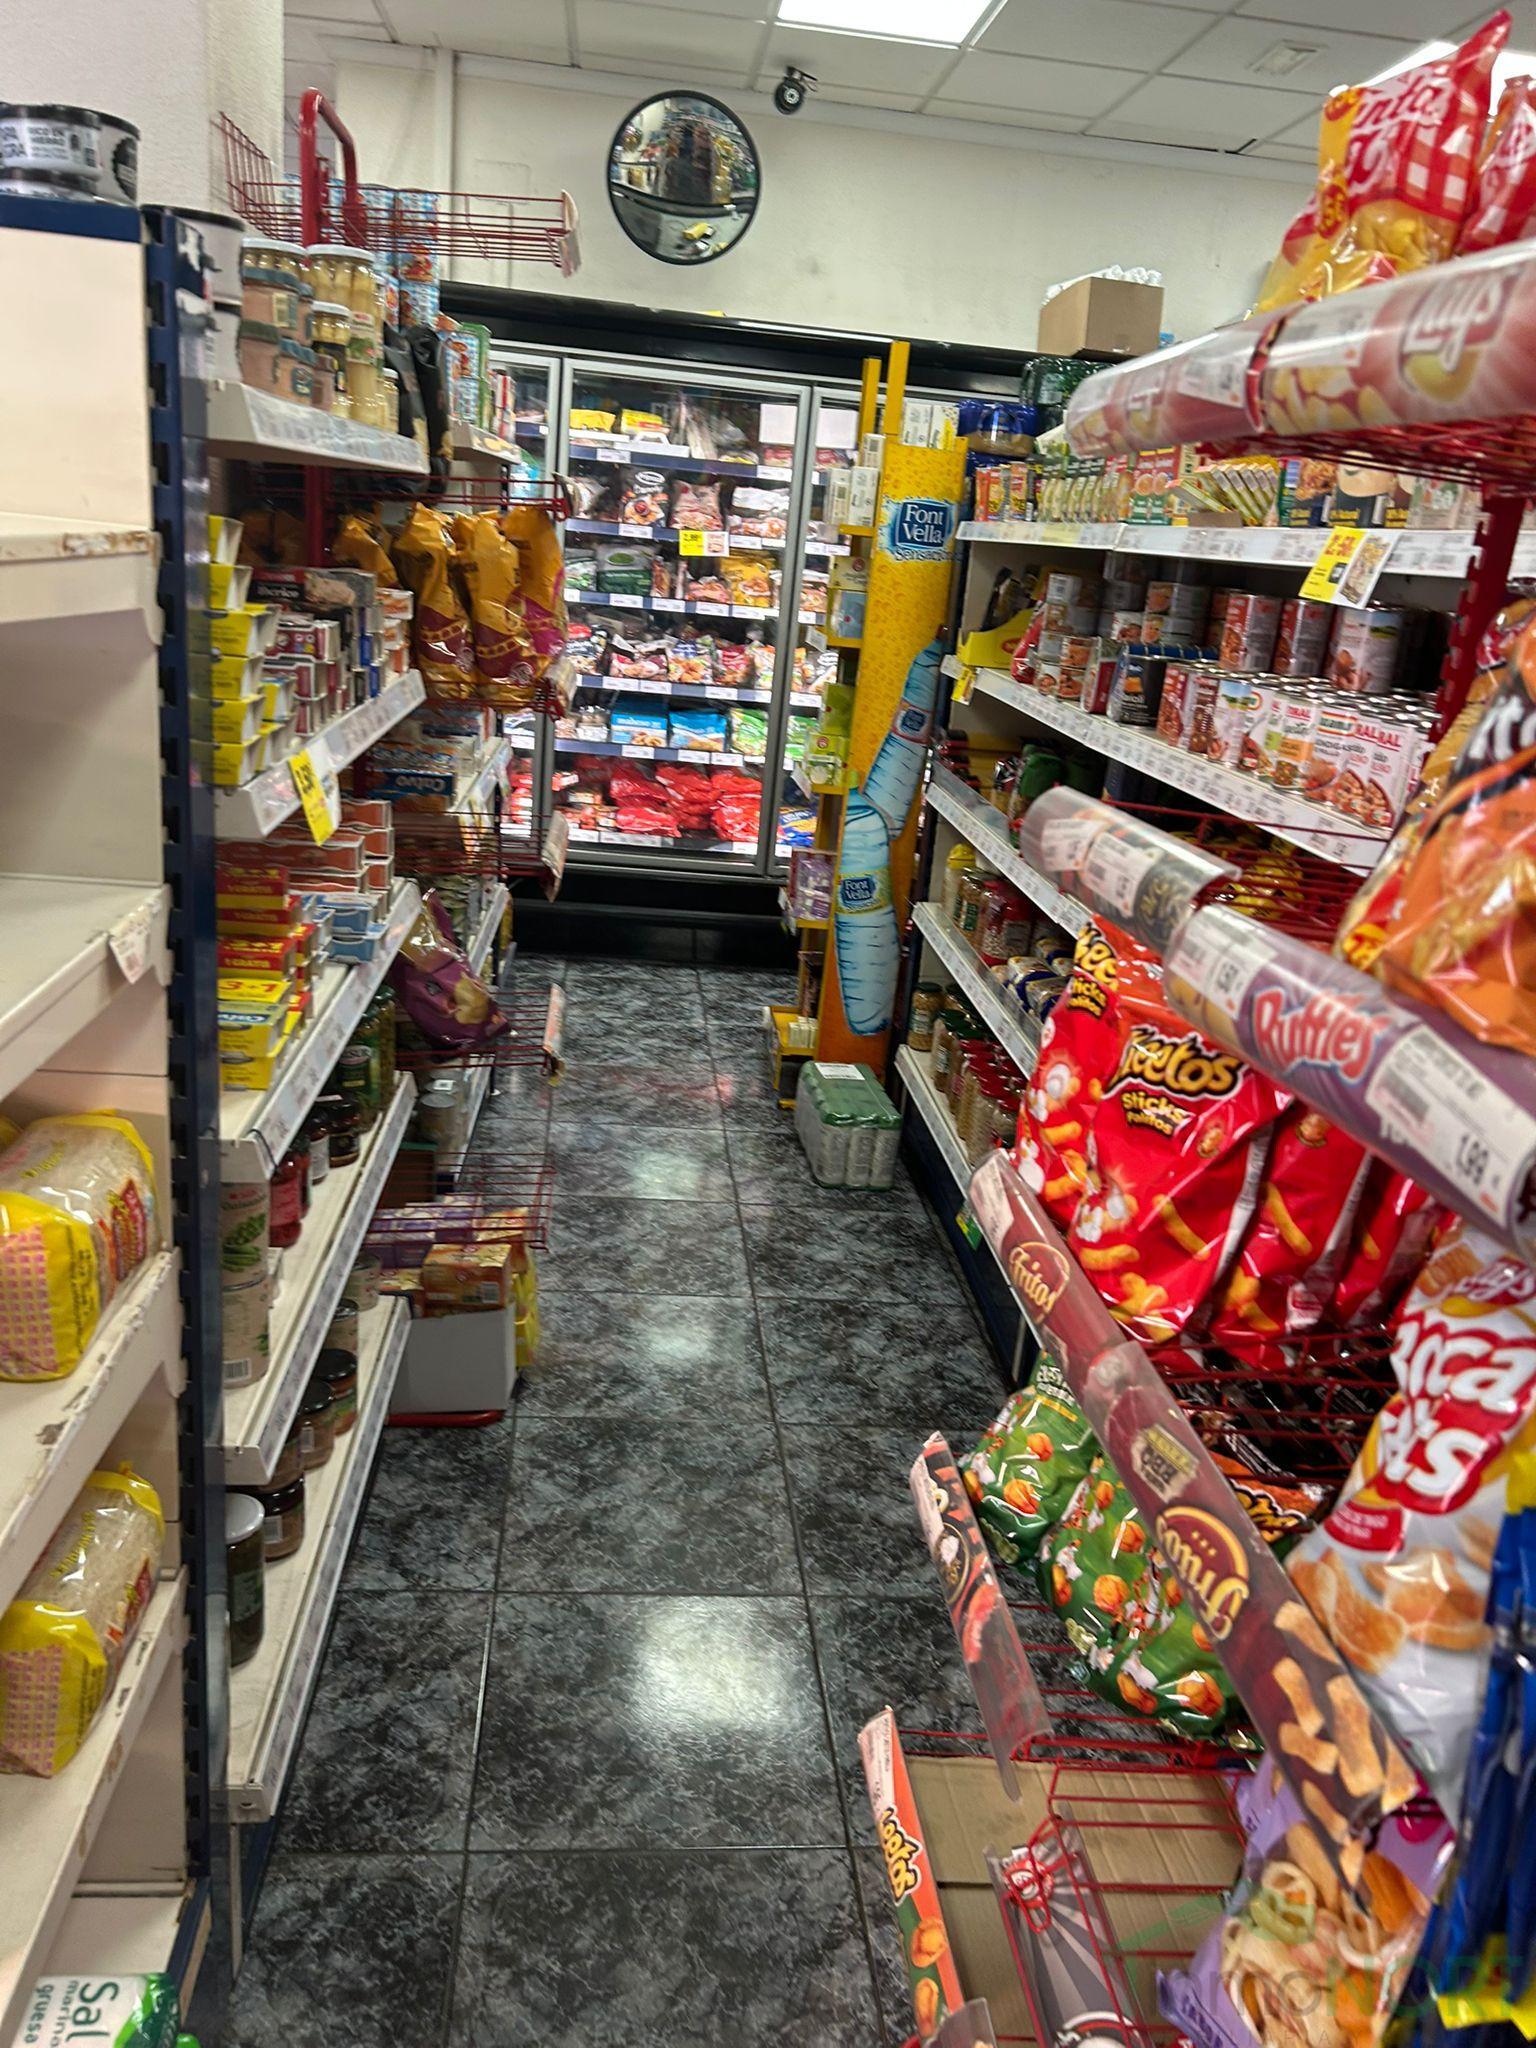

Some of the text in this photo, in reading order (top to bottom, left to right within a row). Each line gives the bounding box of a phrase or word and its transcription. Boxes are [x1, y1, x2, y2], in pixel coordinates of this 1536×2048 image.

[902, 522, 944, 544] Vella
[903, 504, 944, 526] Font
[1254, 986, 1393, 1082] Ruffles
[1009, 1246, 1058, 1315] Fritos
[24, 1984, 55, 2044] gruesa
[66, 1981, 120, 2042] Sal
